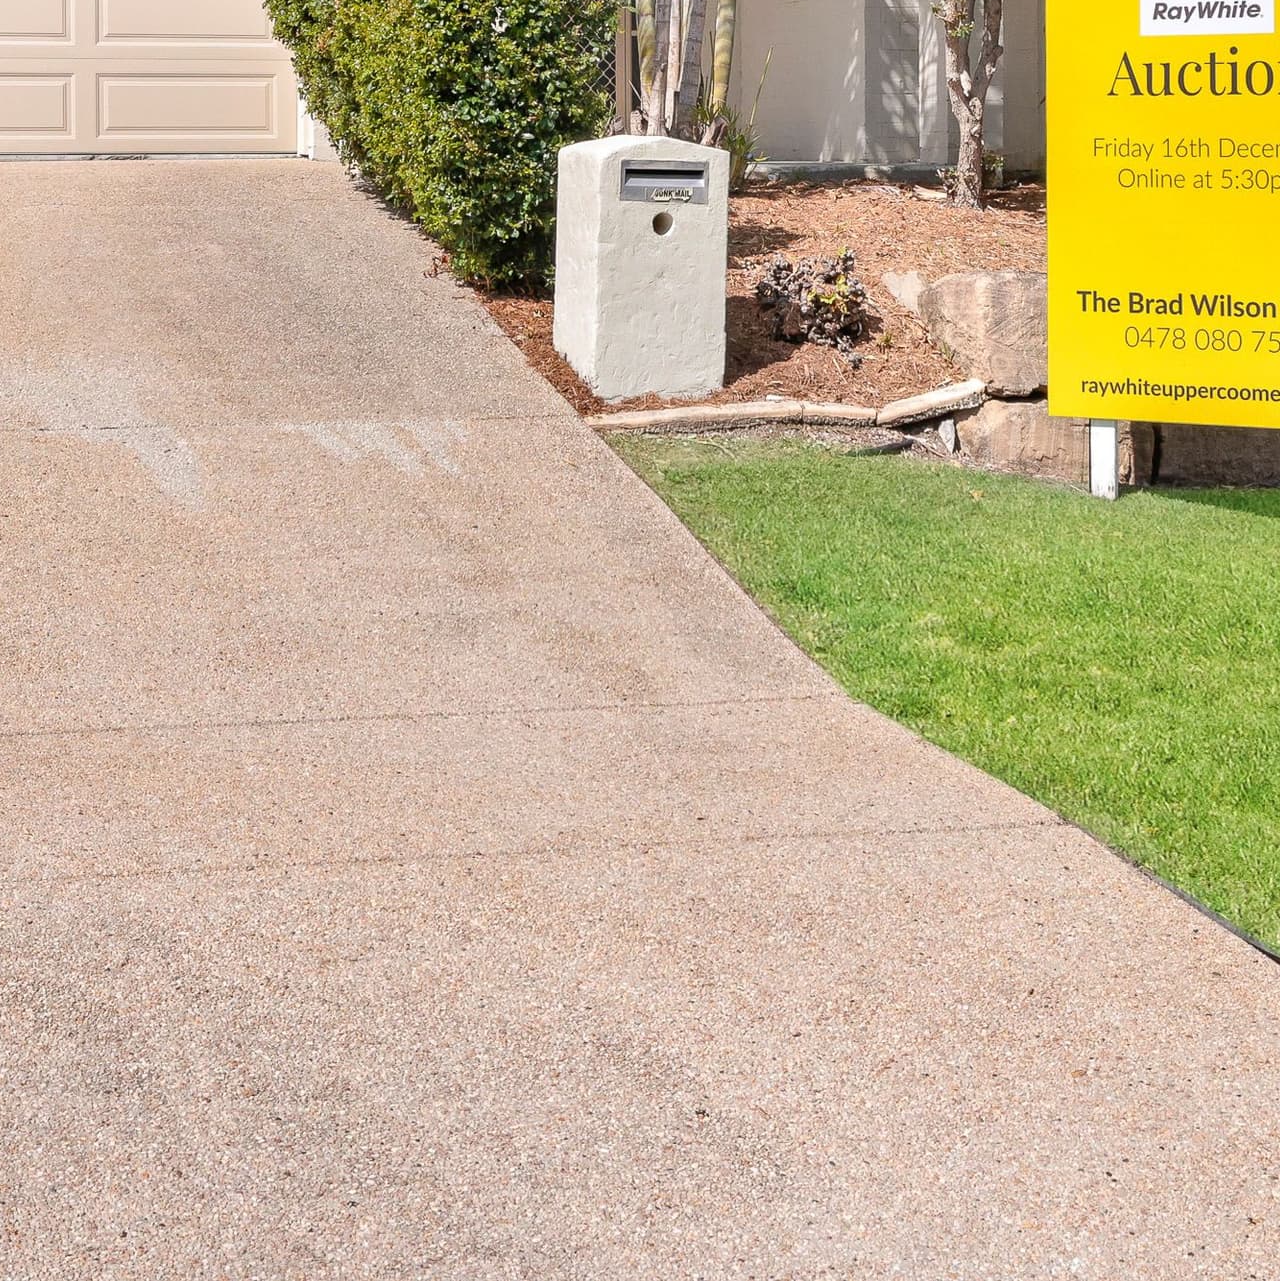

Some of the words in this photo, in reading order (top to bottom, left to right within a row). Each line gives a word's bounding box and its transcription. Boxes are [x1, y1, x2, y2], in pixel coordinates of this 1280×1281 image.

[1093, 138, 1154, 161] Friday
[1162, 138, 1210, 158] 16th
[1118, 168, 1185, 189] Online
[1193, 171, 1213, 189] at
[1076, 290, 1121, 313] The
[1129, 292, 1183, 316] Brad
[1190, 294, 1277, 318] Wilson
[1124, 326, 1186, 350] 0478
[1194, 329, 1242, 351] 080
